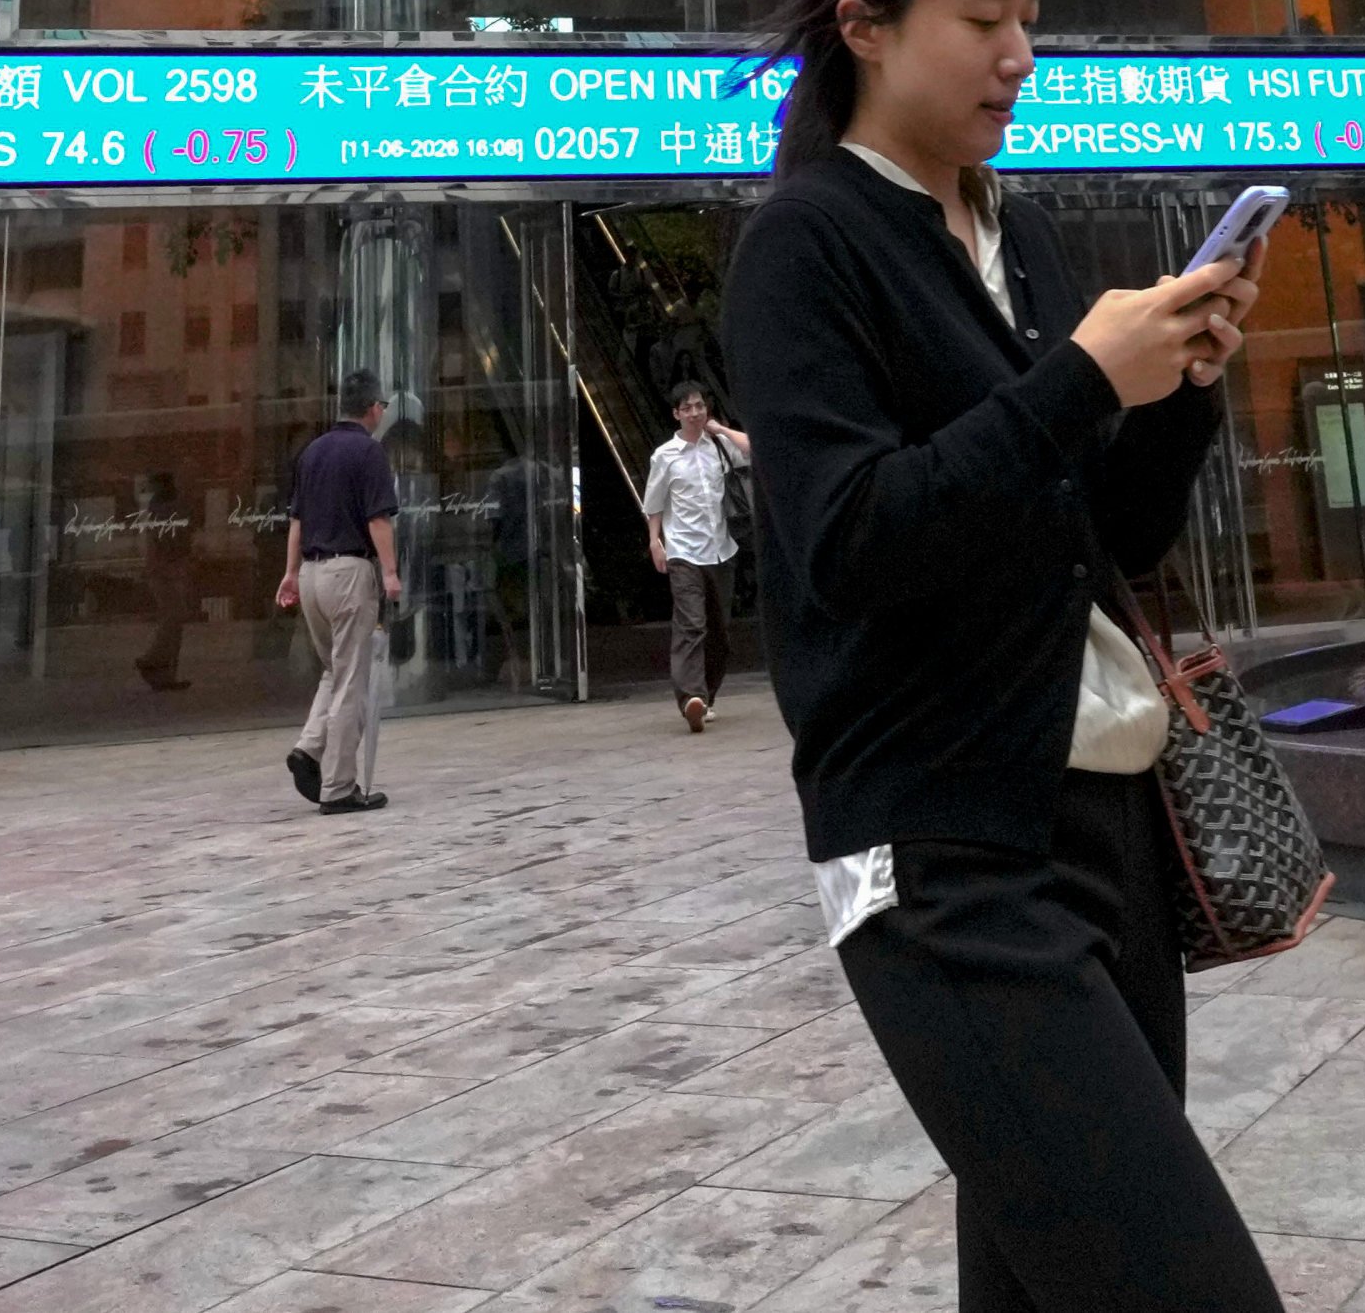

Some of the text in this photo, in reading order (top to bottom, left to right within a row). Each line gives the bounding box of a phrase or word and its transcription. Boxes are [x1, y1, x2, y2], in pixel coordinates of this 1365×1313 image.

[62, 69, 147, 105] VOL
[165, 68, 258, 104] 2598
[299, 62, 529, 110] 未平倉合約
[549, 67, 655, 102] OPEN
[666, 68, 725, 101] INT
[1248, 68, 1300, 98] HSI
[42, 130, 126, 168] 74.6
[535, 125, 638, 161] 02057
[1004, 122, 1204, 154] EXPRESS-W
[1222, 120, 1302, 153] 175.3
